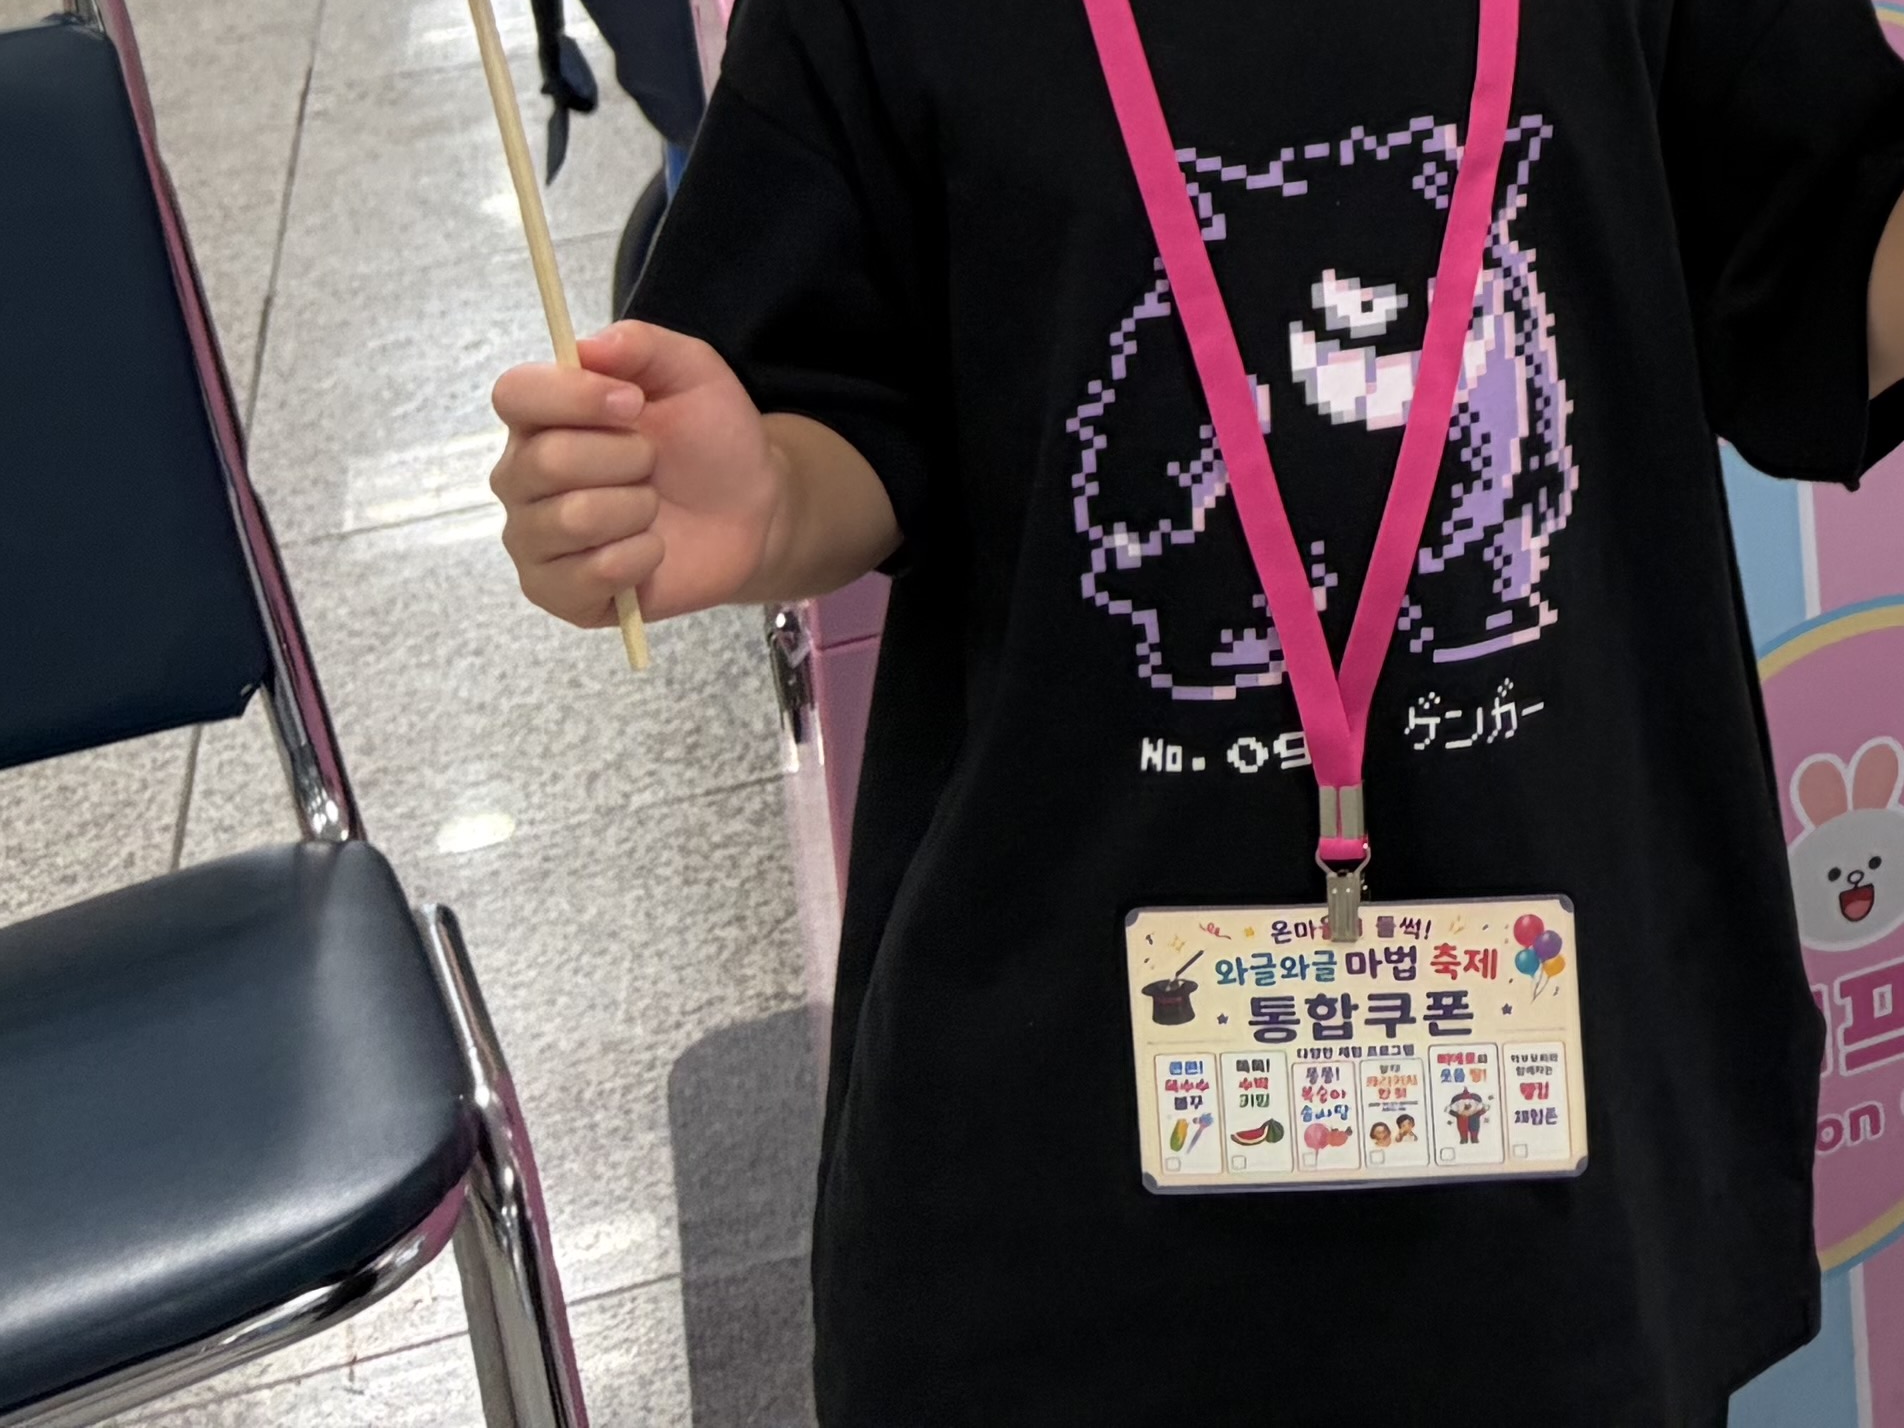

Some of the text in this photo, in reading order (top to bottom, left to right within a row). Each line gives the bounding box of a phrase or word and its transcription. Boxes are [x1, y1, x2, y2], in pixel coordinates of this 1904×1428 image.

[1404, 677, 1545, 751] ゲンガー
[1214, 942, 1499, 988] 와글와글 마법 축제
[1247, 989, 1475, 1044] 통합쿠폰
